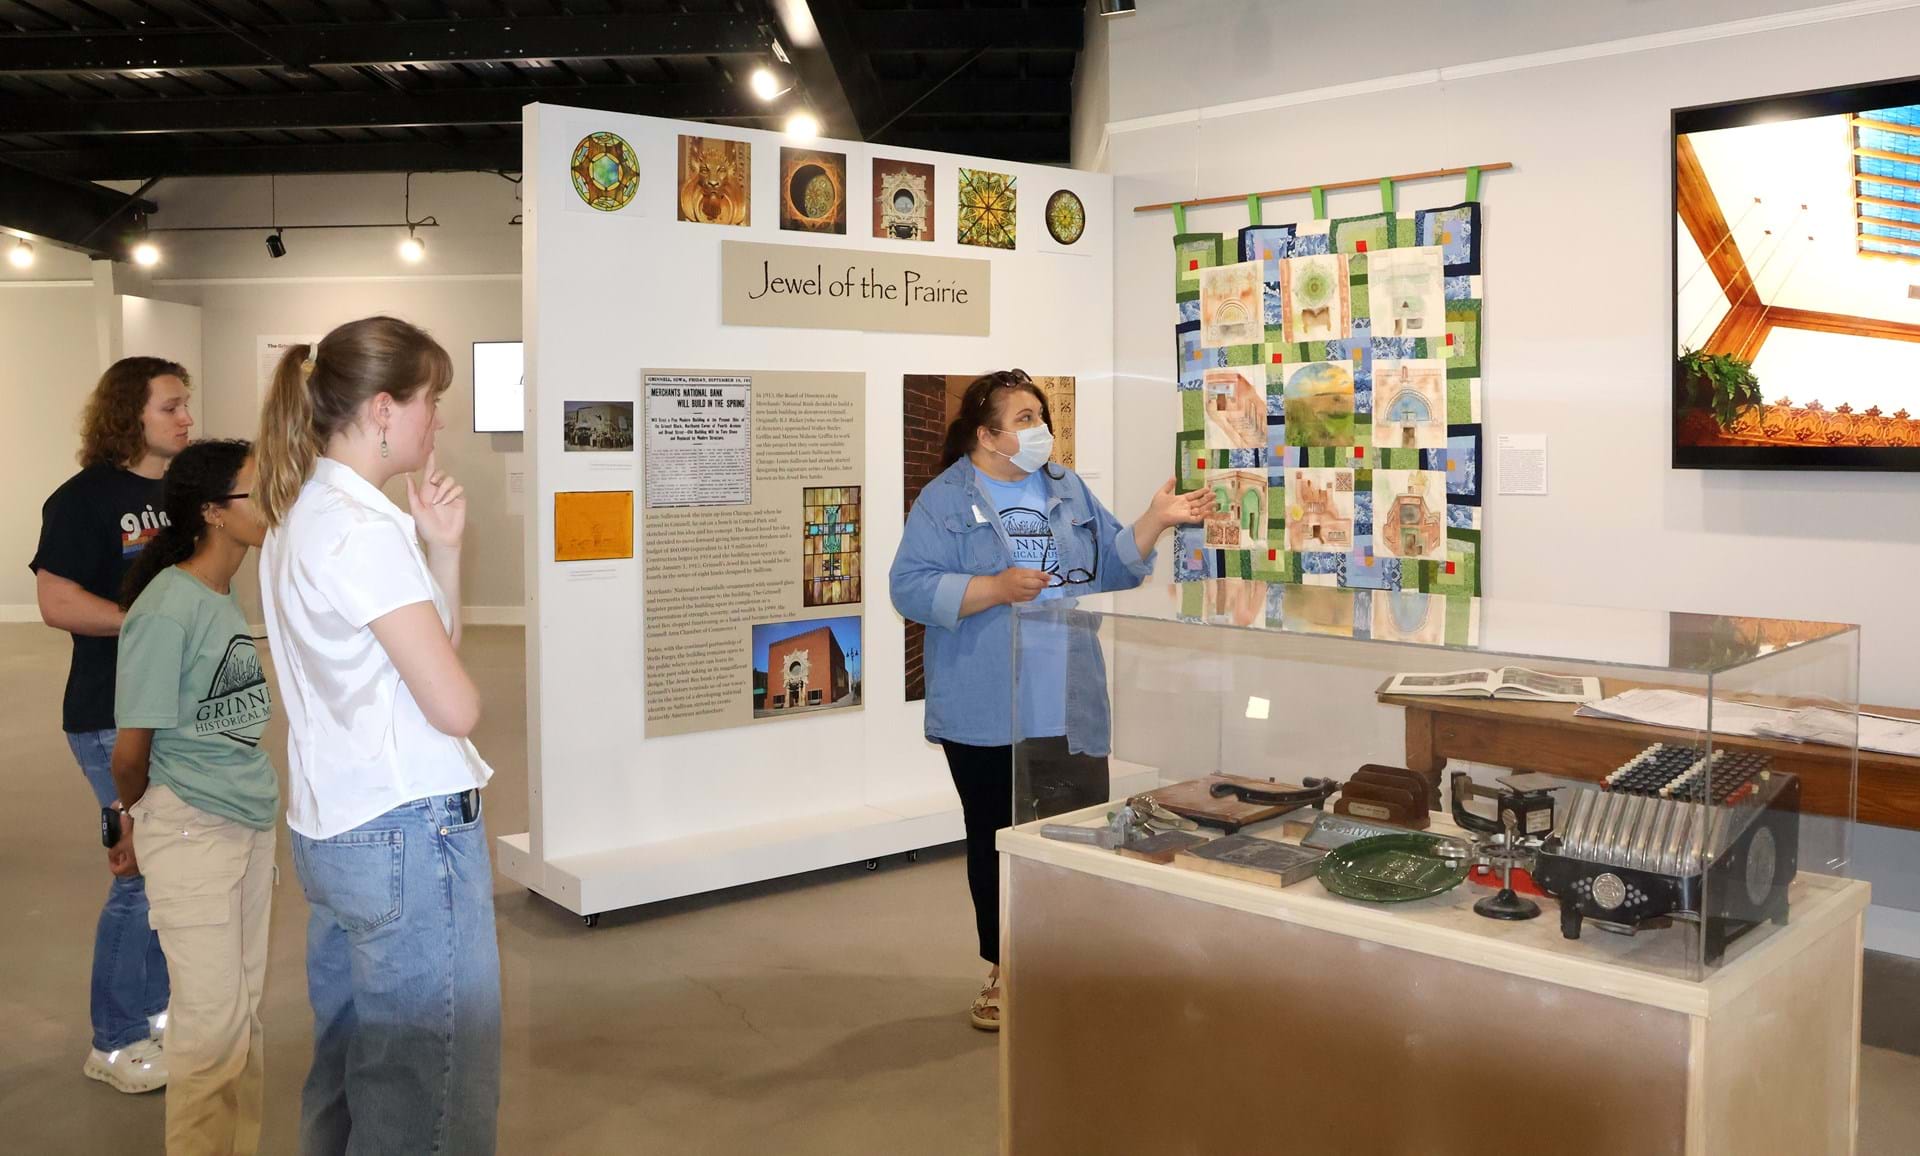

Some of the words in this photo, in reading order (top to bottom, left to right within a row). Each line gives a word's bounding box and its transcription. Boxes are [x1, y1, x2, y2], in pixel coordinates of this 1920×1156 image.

[748, 260, 822, 300] Jewel
[828, 266, 856, 297] of
[860, 267, 898, 300] the
[904, 270, 969, 307] Prairie
[651, 388, 680, 397] MERCHANTS
[683, 388, 707, 397] NATIONAL
[677, 400, 689, 408] WILL
[195, 711, 260, 733] HISTORICAL
